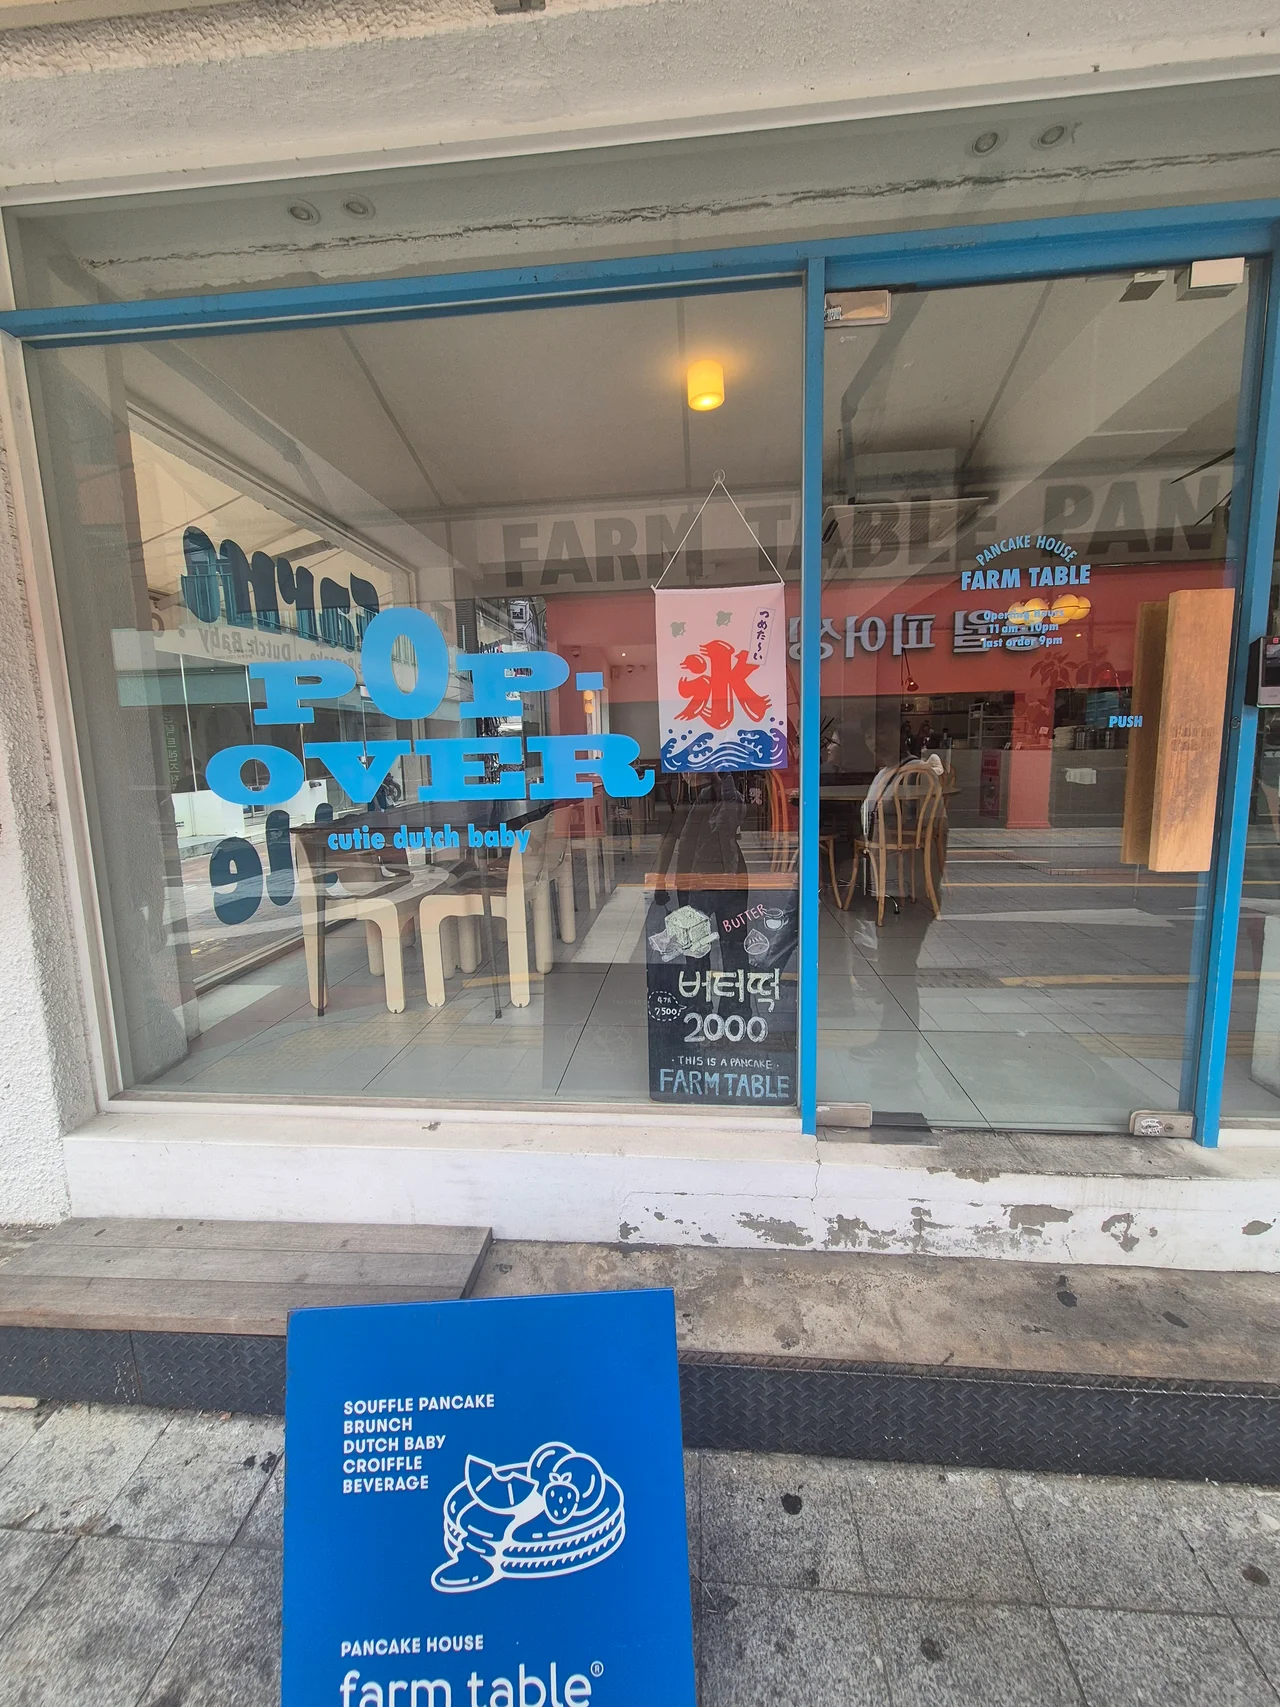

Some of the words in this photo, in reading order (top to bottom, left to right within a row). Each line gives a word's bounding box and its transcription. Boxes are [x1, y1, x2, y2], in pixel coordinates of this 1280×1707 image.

[502, 511, 705, 588] FARM
[976, 535, 1031, 567] PANCAKE
[1036, 535, 1078, 563] HOUSE
[961, 568, 1021, 591] FARM
[1029, 564, 1091, 587] TABLE
[1034, 609, 1064, 618] Hours
[1030, 622, 1059, 635] 10pm
[982, 638, 1003, 648] last
[1006, 635, 1036, 647] order
[1039, 634, 1063, 647] 9pm
[673, 639, 773, 731] 氷
[1109, 715, 1143, 728] PUSH
[205, 733, 656, 806] OVER
[327, 825, 385, 850] cutie
[393, 823, 460, 849] dutch
[467, 823, 531, 853] baby
[722, 903, 766, 933] BUTTER
[678, 967, 781, 1013] 버터떡
[654, 1007, 678, 1016] 7500
[683, 1012, 769, 1043] 2000
[677, 1056, 703, 1066] THIS
[707, 1057, 717, 1067] IS
[720, 1057, 728, 1067] A
[730, 1057, 773, 1069] PANCAKE
[343, 1398, 414, 1415] SOUFFLE
[418, 1393, 495, 1411] PANCAKE
[343, 1417, 413, 1434] BRUNCH
[343, 1437, 399, 1454] DUTCH
[404, 1435, 446, 1451] BABY
[342, 1455, 422, 1474] CROIFFLE
[342, 1475, 429, 1494] BEVERAGE
[340, 1636, 421, 1657] PANCAKE
[426, 1634, 484, 1652] HOUSE
[339, 1669, 452, 1707] farm
[467, 1662, 592, 1707] table
